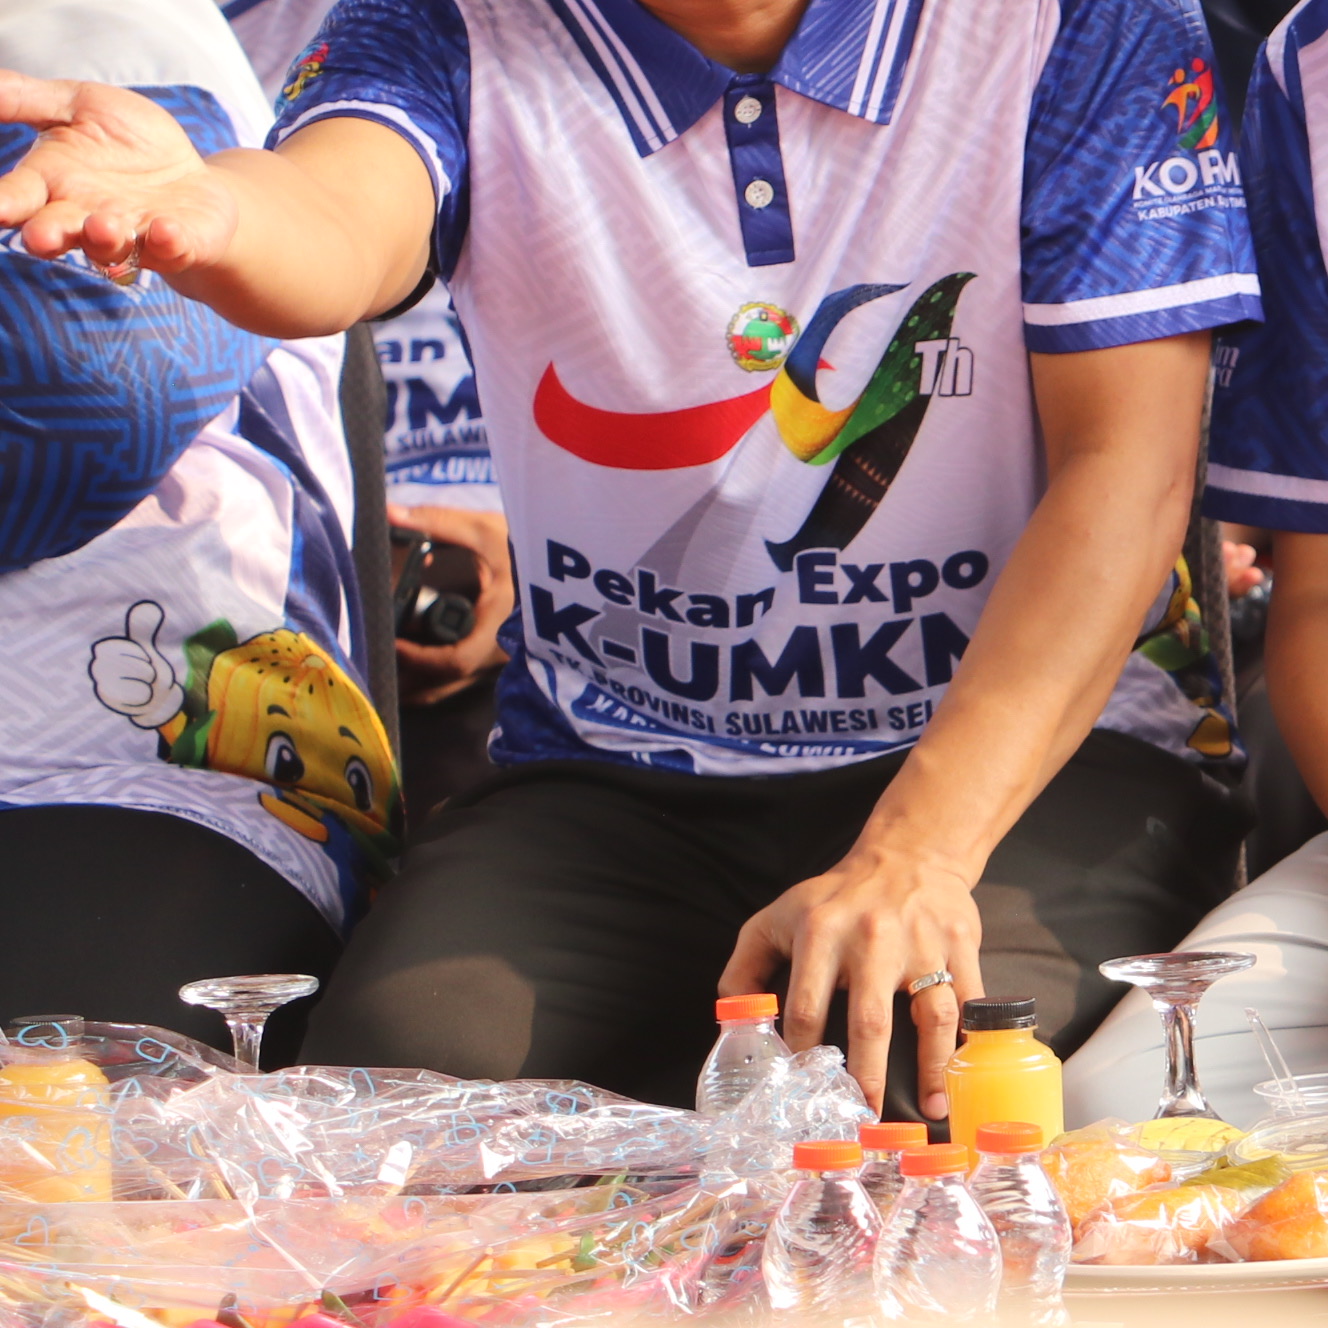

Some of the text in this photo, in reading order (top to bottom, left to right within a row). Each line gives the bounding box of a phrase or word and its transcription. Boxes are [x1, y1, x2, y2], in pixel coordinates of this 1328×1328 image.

[1137, 197, 1216, 221] KABUPATEN
[914, 337, 975, 398] Th
[546, 539, 990, 629] Pekan Expo
[726, 708, 878, 738] SULAWESI
